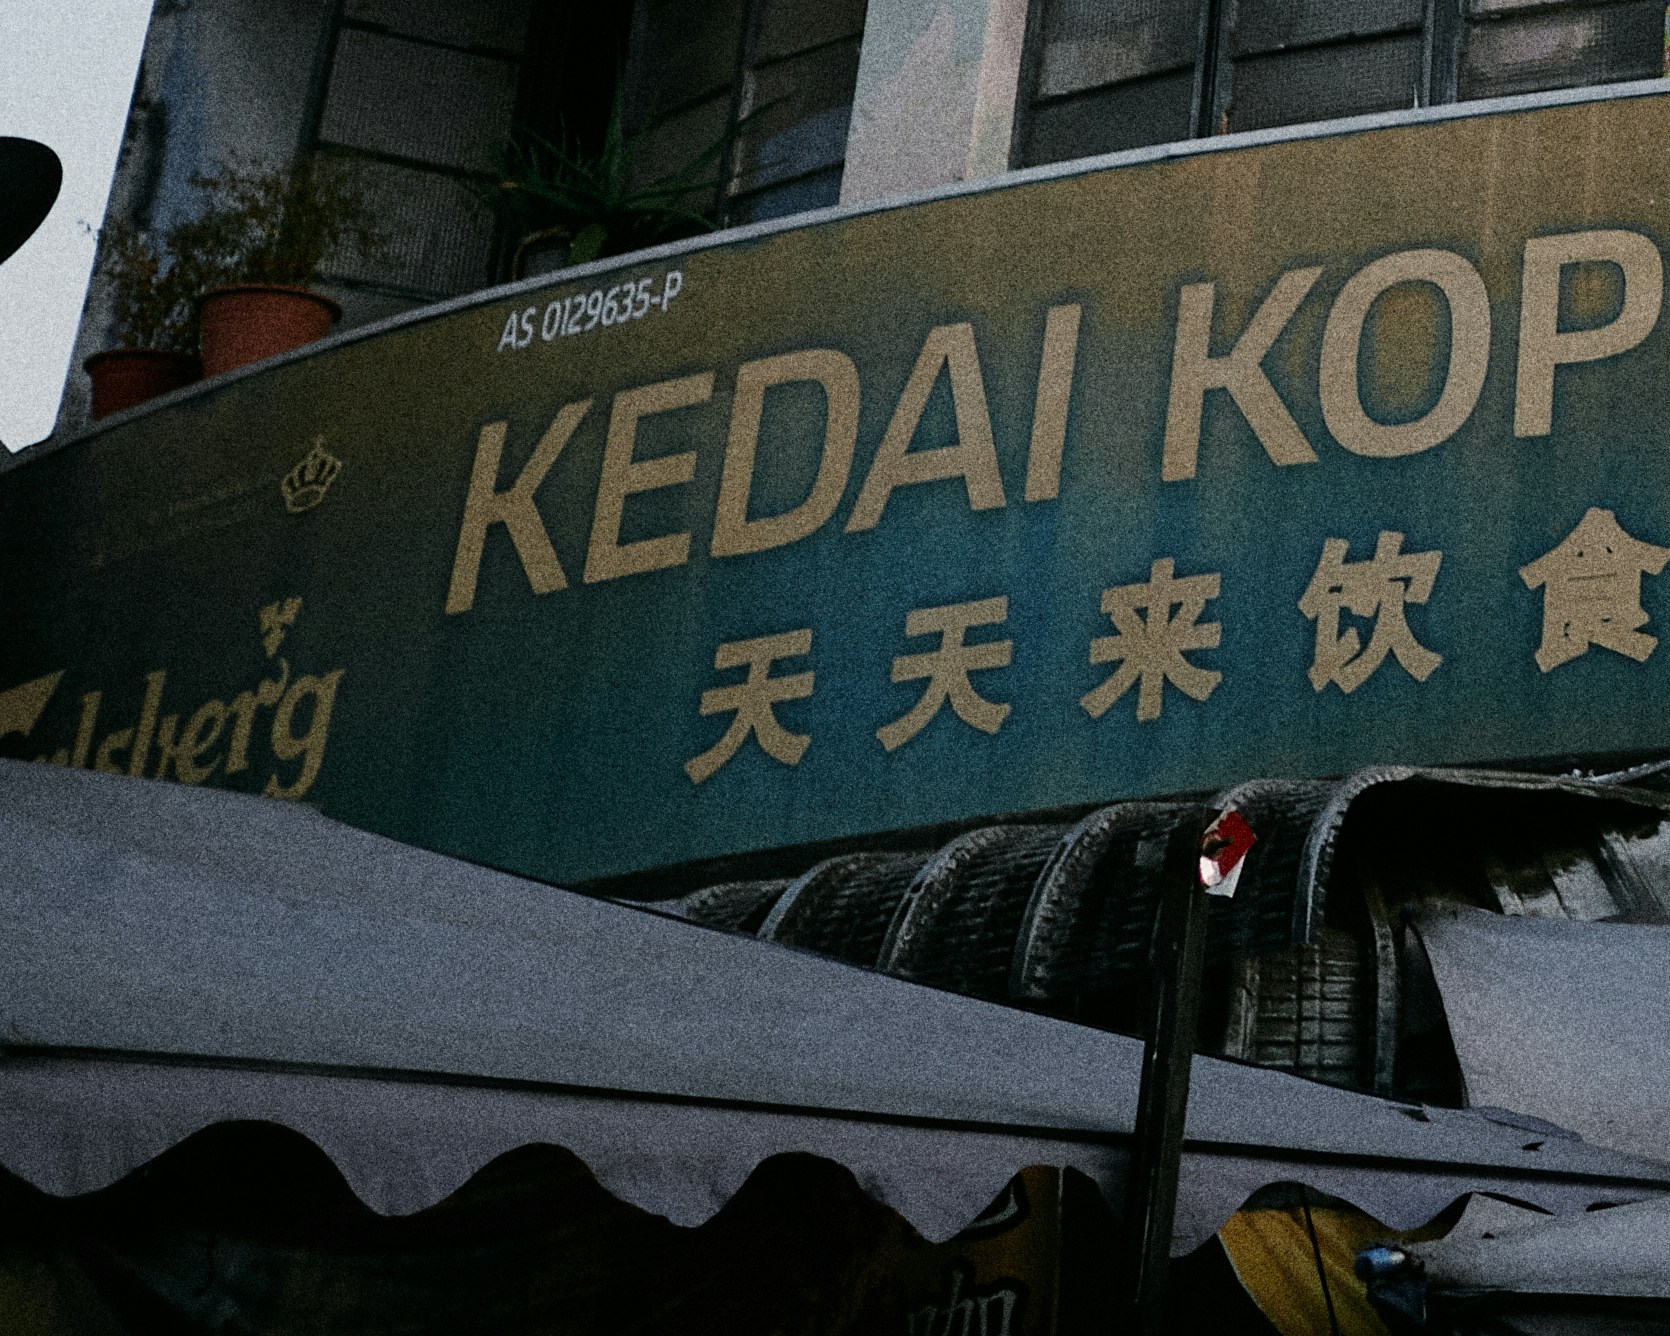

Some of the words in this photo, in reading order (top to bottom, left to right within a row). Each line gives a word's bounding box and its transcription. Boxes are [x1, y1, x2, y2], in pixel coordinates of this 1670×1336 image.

[496, 306, 537, 353] AS
[541, 269, 684, 342] 0129635-P
[445, 303, 1081, 616] KEDAI
